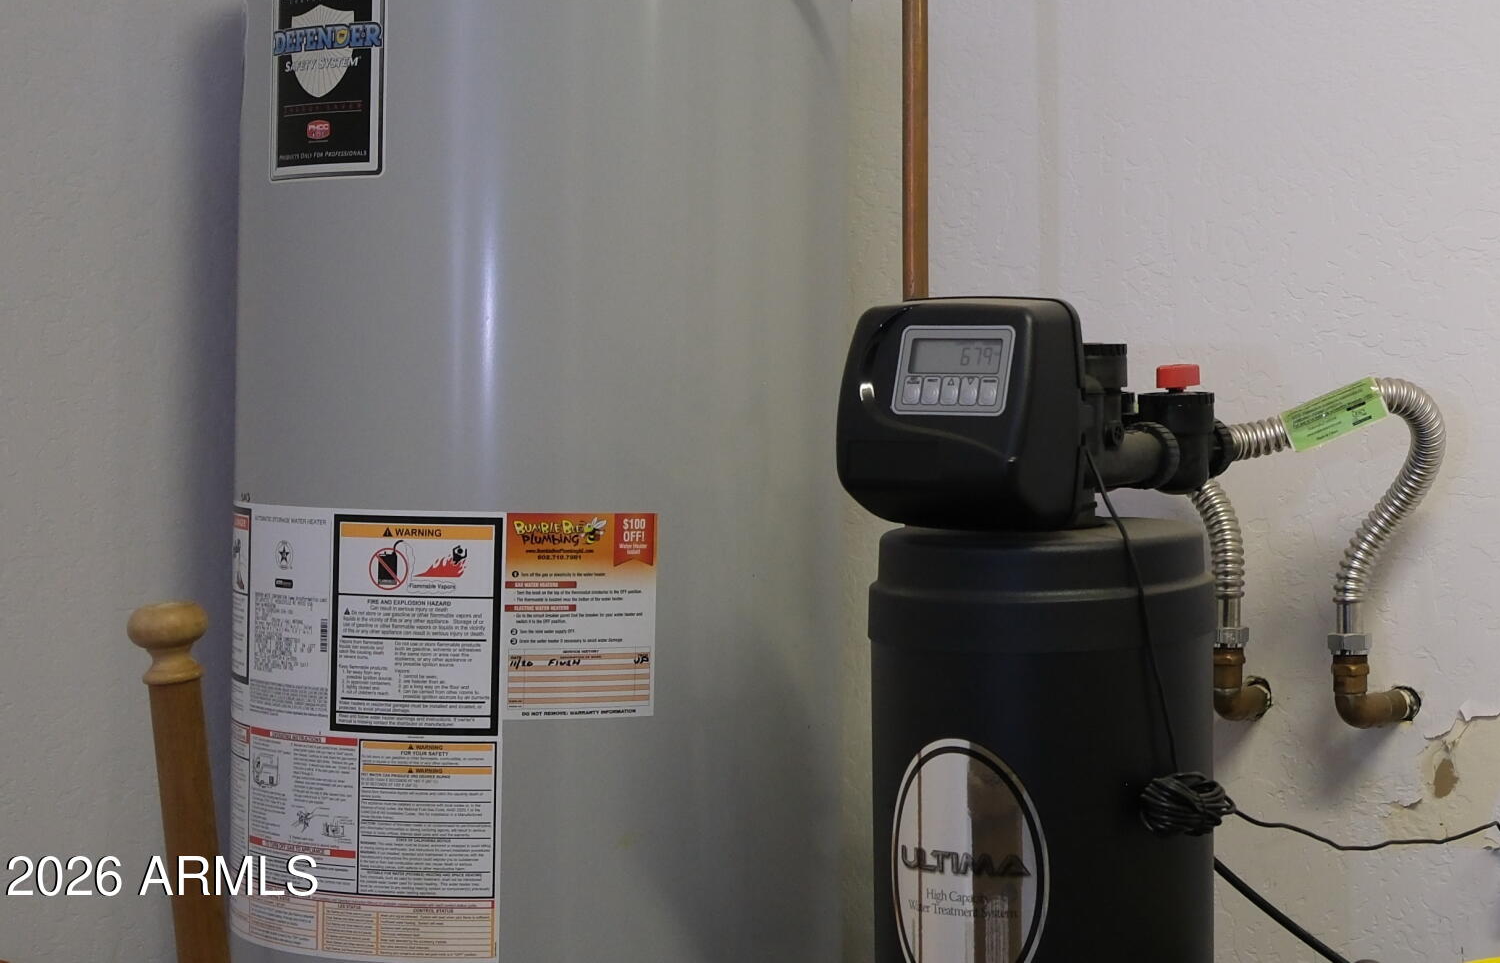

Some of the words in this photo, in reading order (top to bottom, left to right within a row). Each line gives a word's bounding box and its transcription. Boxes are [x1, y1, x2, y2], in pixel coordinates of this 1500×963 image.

[273, 21, 384, 56] DEFENDER
[285, 60, 318, 73] SAFETY
[319, 57, 358, 69] SYSTEM
[325, 149, 367, 158] PROFESSIONALS
[960, 347, 993, 366] 679
[513, 520, 560, 535] BUMBLE
[623, 518, 645, 529] $100
[395, 528, 442, 538] WARNING
[521, 534, 580, 546] PLUMBING
[623, 531, 645, 541] OFF!
[901, 844, 1032, 877] ULTIMA
[926, 888, 947, 905] High
[908, 899, 930, 913] Water
[933, 903, 978, 918] Treatment
